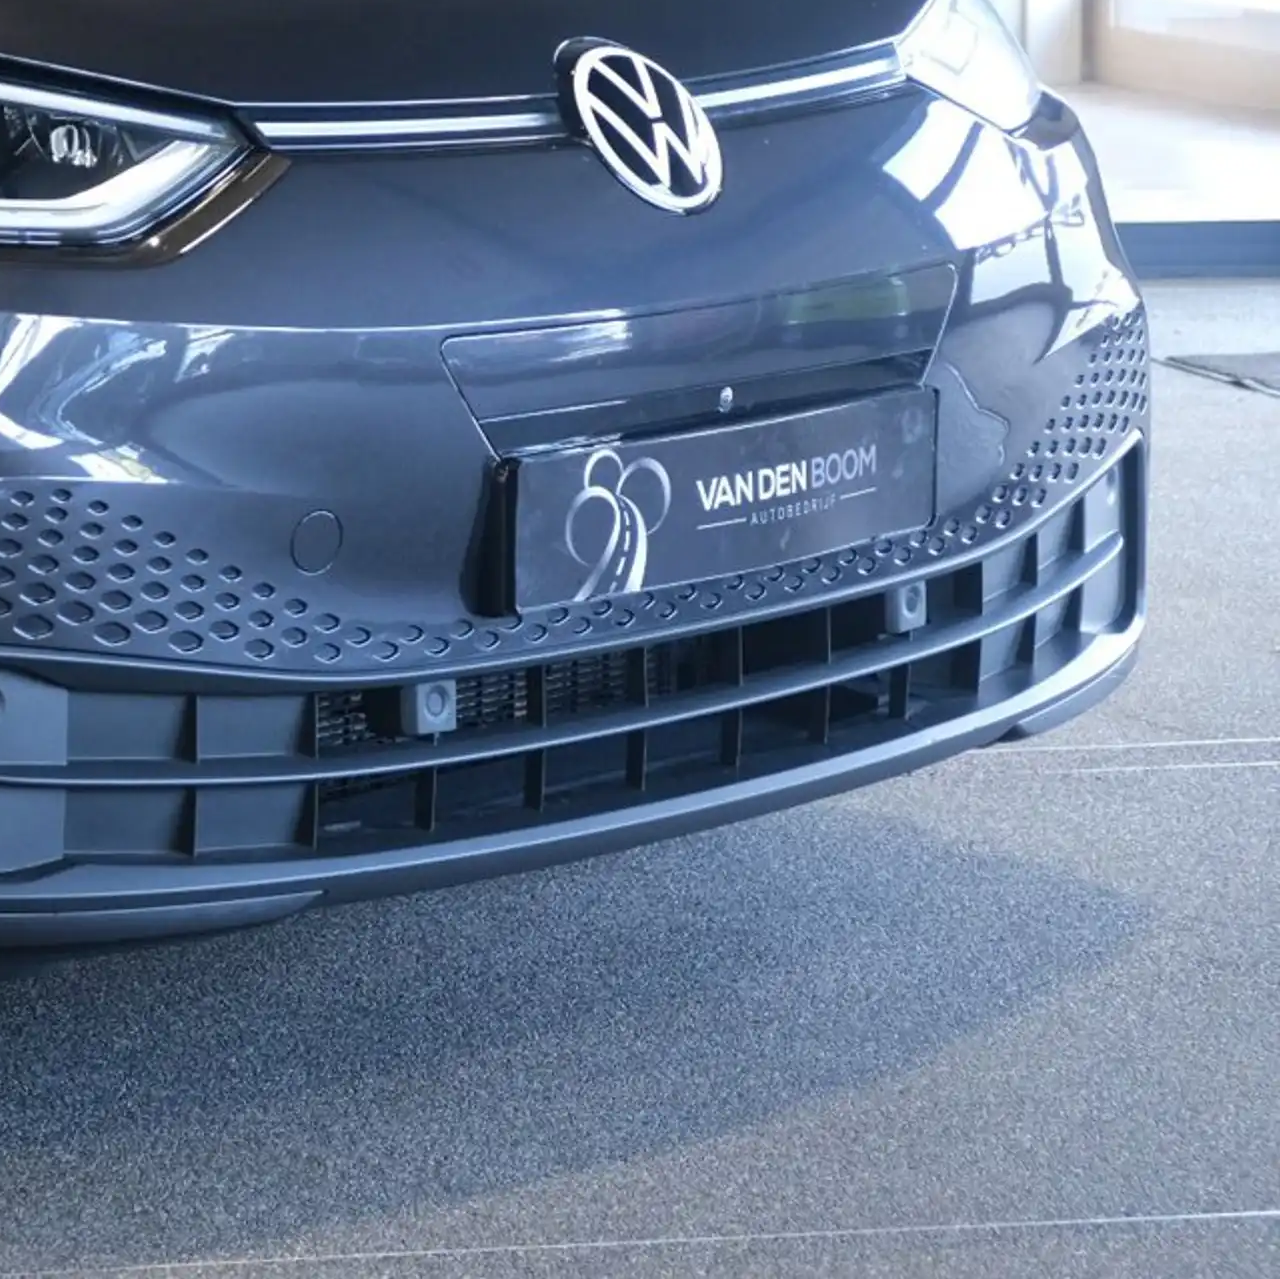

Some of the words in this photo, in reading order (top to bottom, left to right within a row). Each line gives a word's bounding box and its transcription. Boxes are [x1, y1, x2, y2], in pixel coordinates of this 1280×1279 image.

[696, 471, 753, 511] VAN
[758, 460, 807, 500] DEN
[810, 444, 877, 488] BOOM
[750, 493, 836, 526] AUTOBEDRIJF
